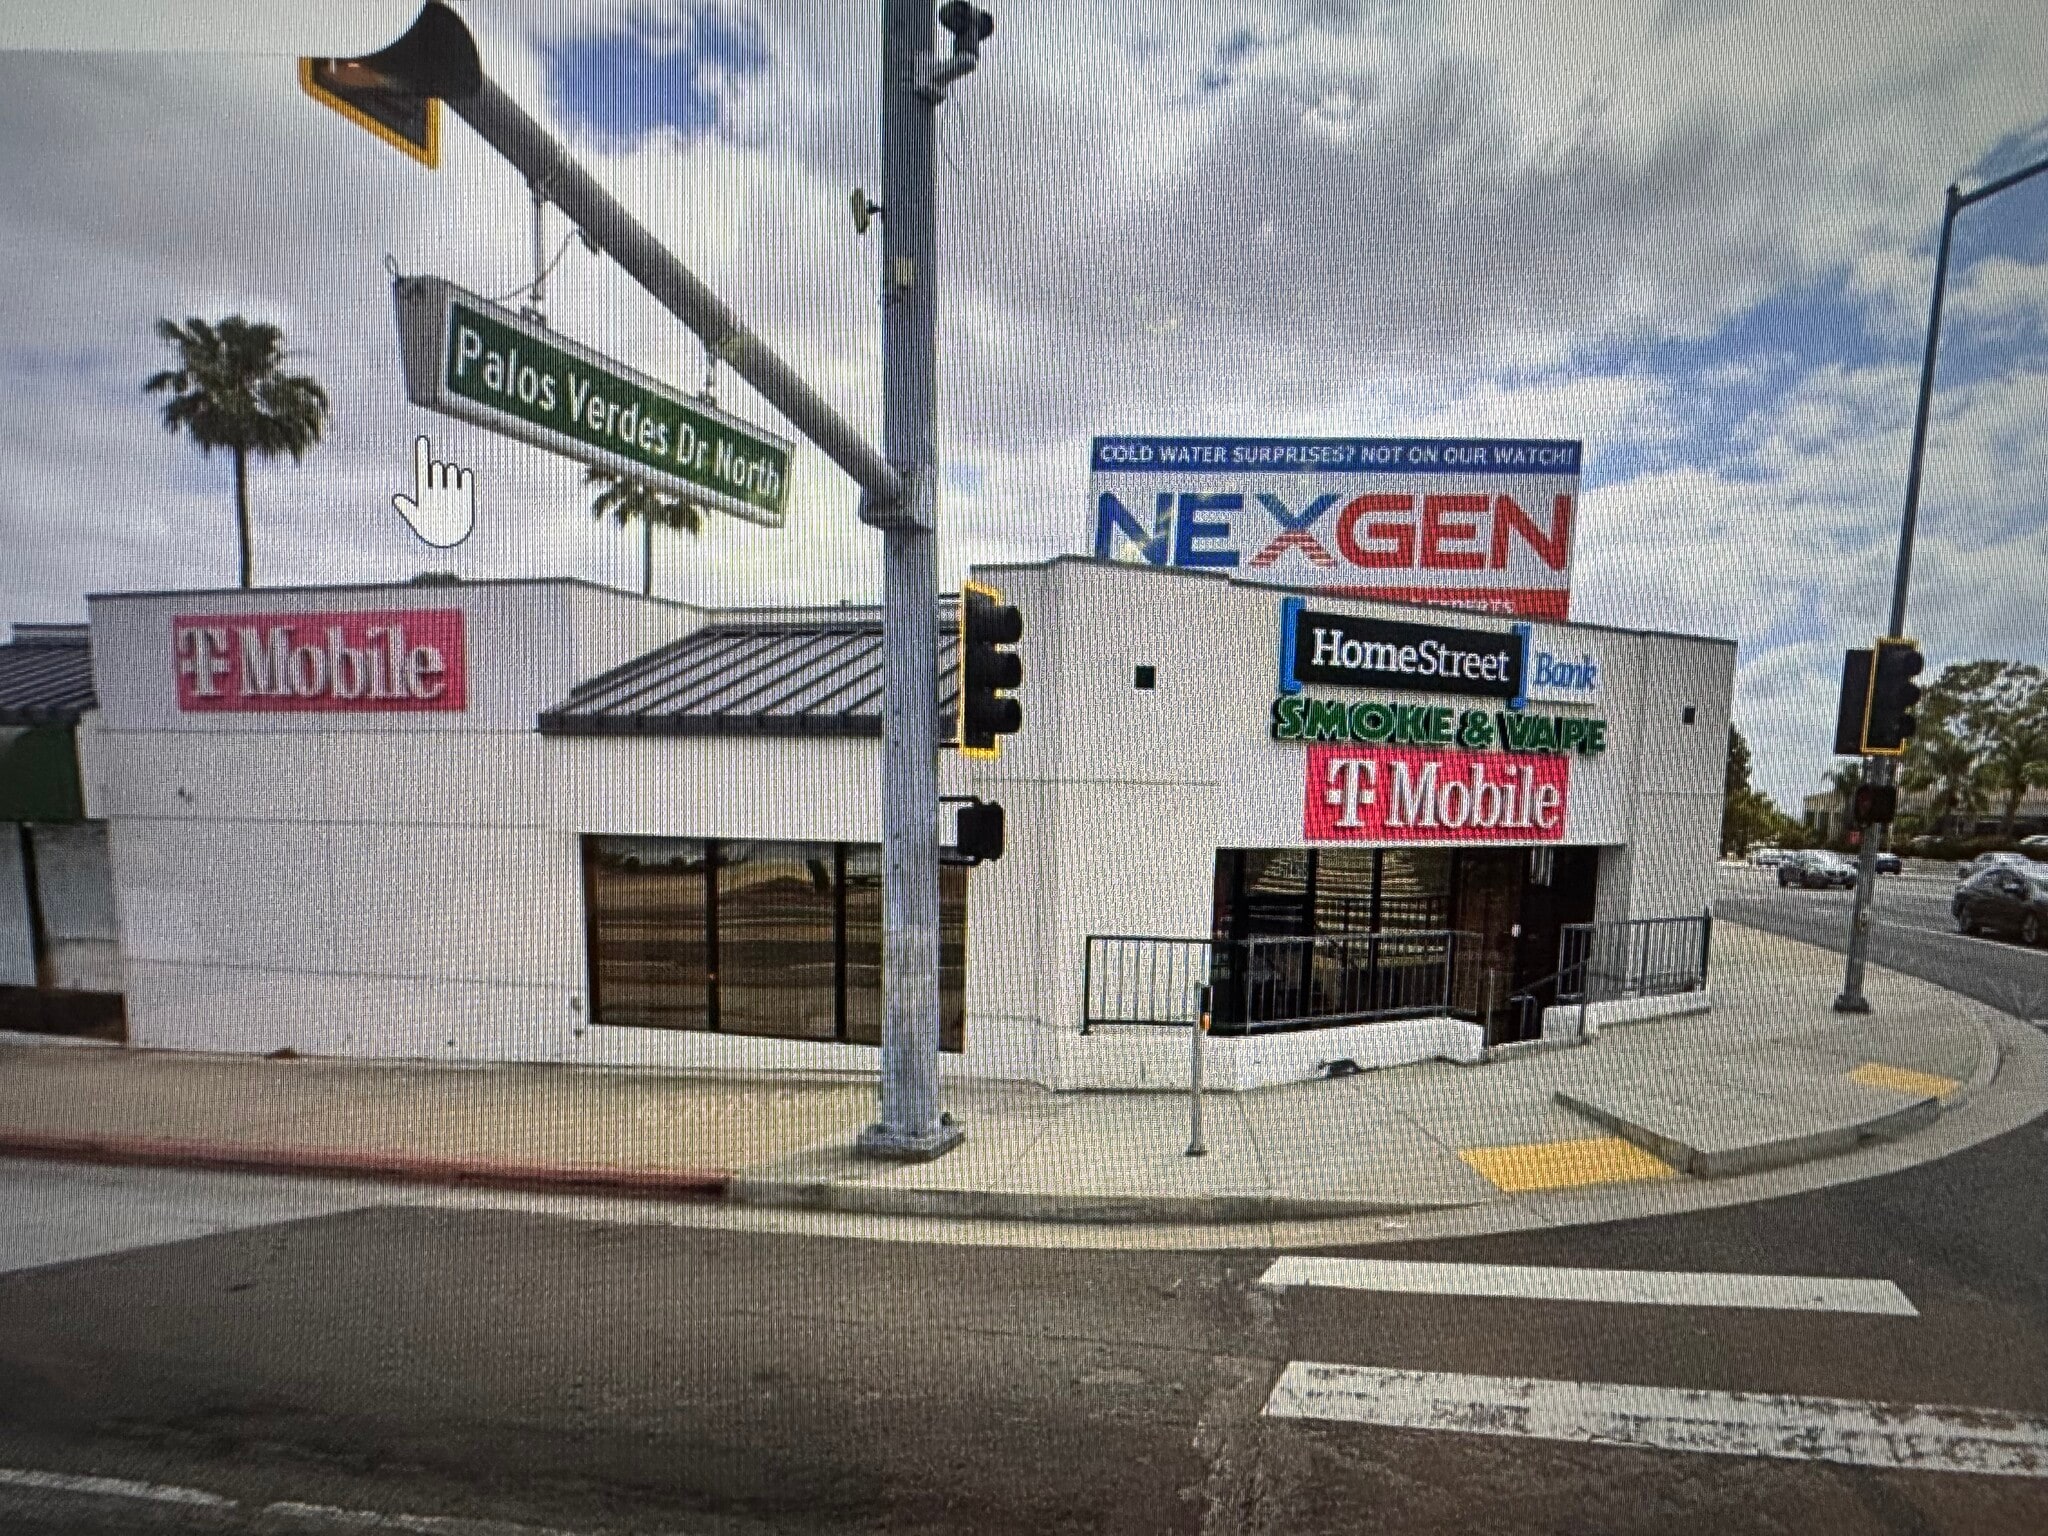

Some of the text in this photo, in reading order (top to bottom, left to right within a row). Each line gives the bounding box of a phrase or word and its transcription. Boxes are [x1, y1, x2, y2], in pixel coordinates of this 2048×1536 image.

[456, 325, 780, 498] Palos Verdes Dr North
[1101, 444, 1574, 465] COLD WATER SURPRISES? NOT ON OUR WATCH!
[1095, 491, 1569, 571] NEXGEN
[1310, 627, 1598, 691] HomeStreet Bank
[1275, 694, 1607, 752] SMOKE & VAPE
